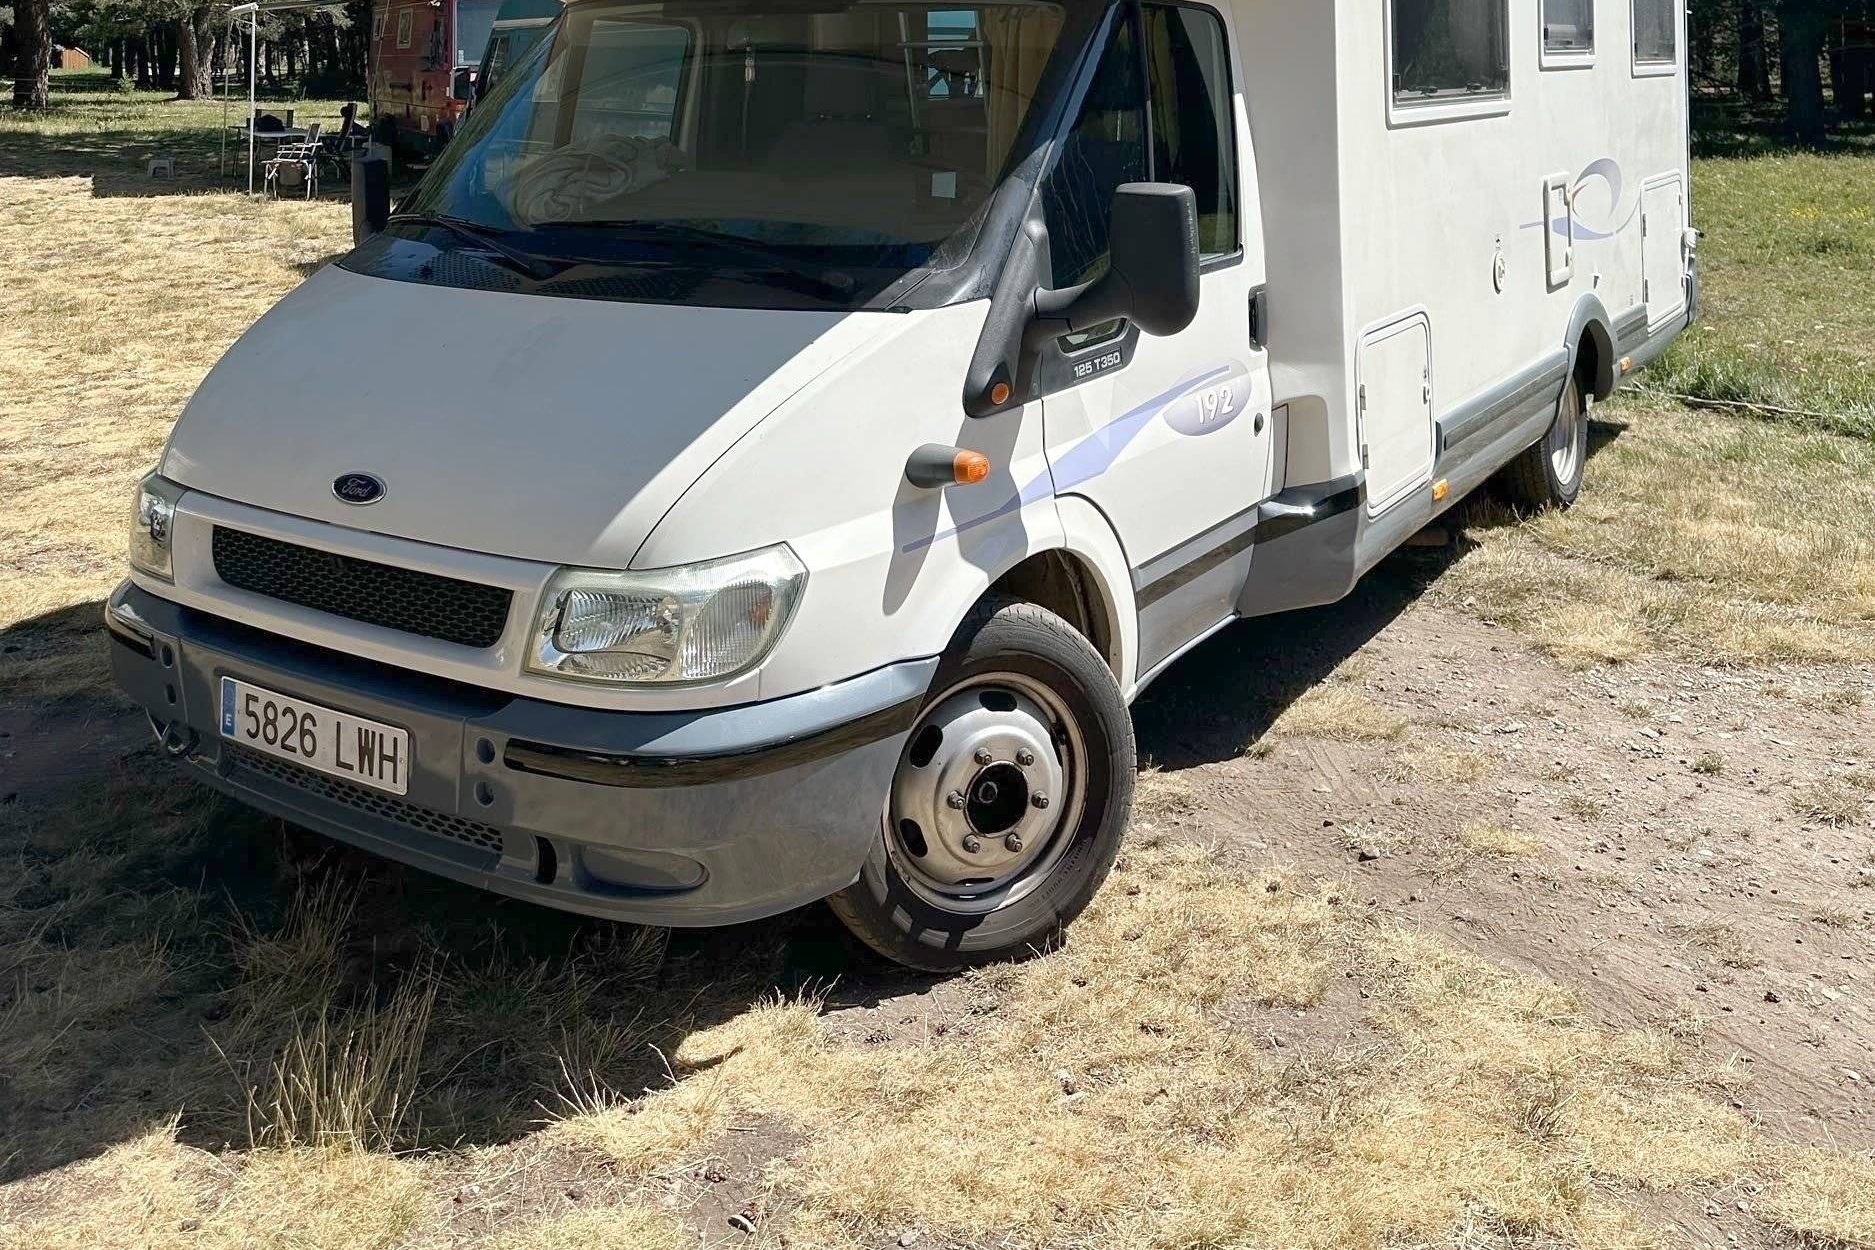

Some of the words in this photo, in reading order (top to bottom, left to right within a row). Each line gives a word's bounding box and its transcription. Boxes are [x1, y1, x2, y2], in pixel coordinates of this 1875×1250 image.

[1074, 361, 1093, 378] 125
[1094, 351, 1120, 370] T350
[1197, 386, 1234, 424] 192
[342, 477, 372, 497] Ford
[225, 713, 232, 727] E
[245, 693, 317, 758] 5826
[335, 721, 398, 784] LWH
